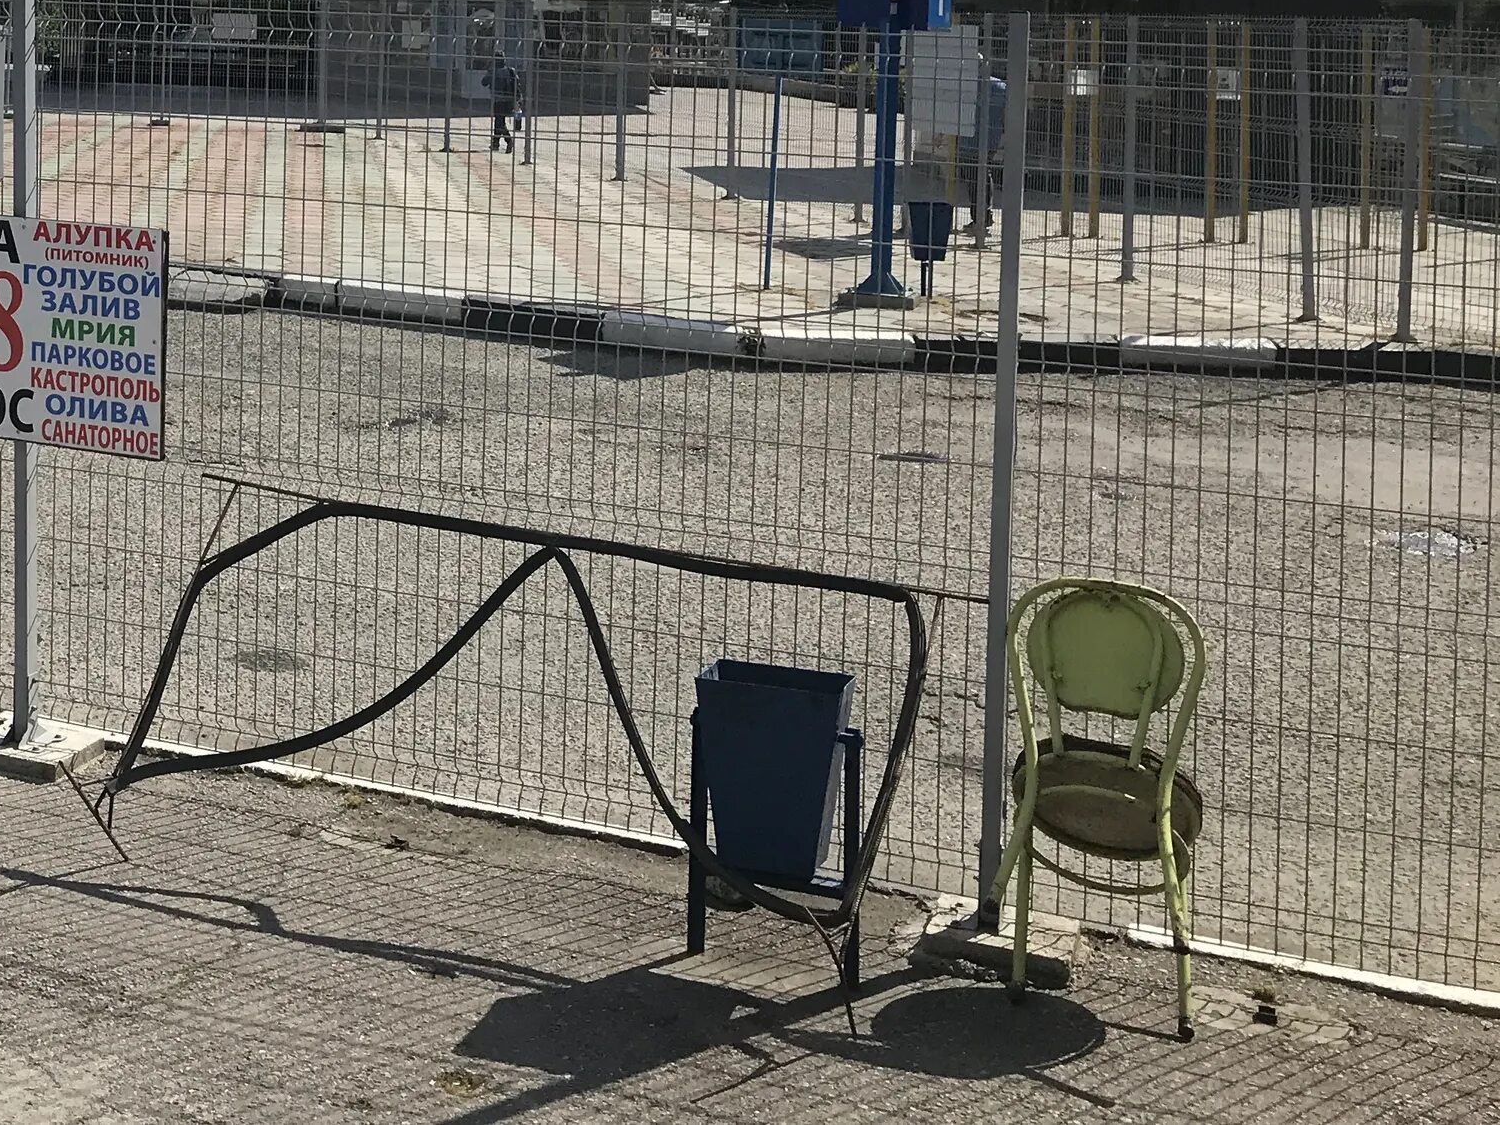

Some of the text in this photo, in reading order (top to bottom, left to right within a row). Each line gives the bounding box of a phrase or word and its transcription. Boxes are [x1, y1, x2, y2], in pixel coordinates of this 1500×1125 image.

[33, 221, 155, 252] АЛУПКА
[45, 247, 149, 270] (ПИТОМНИК)
[23, 263, 161, 298] ГОЛУБОЙ
[41, 290, 141, 321] ЗАЛИВ
[51, 317, 136, 347] МРИЯ
[31, 341, 157, 376] ПАРКОВОЕ
[30, 366, 161, 403] КАСТРОПОЛЬ
[45, 393, 150, 427] ОЛИВА
[41, 418, 159, 456] САНАТОРНОЕ
